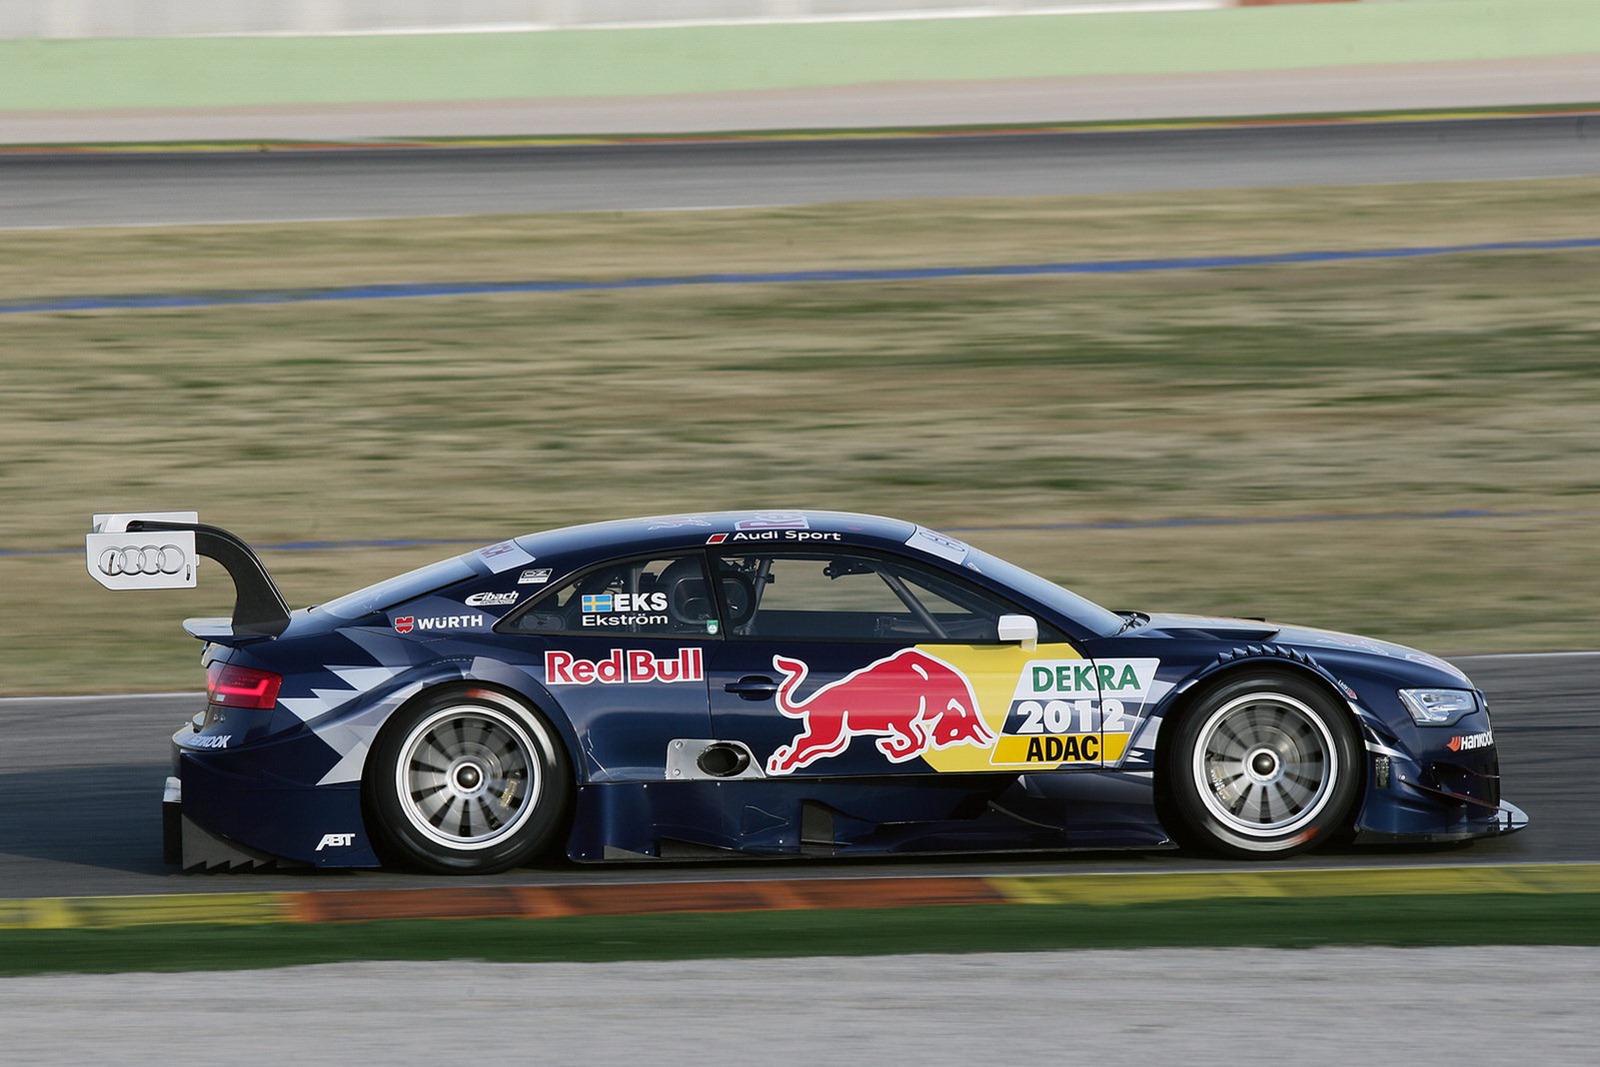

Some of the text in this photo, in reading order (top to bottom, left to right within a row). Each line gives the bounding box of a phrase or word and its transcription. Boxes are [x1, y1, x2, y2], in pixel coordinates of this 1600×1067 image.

[733, 530, 841, 542] Audi Sport
[465, 591, 519, 606] Eibach
[614, 592, 668, 612] EKS
[417, 614, 483, 630] WÜRTH
[582, 613, 668, 627] Ekström
[546, 648, 702, 684] Red Bull
[1032, 664, 1141, 693] DEKRA
[1016, 698, 1125, 734] 2012
[1026, 735, 1099, 762] ADAC
[315, 833, 356, 851] ABT
